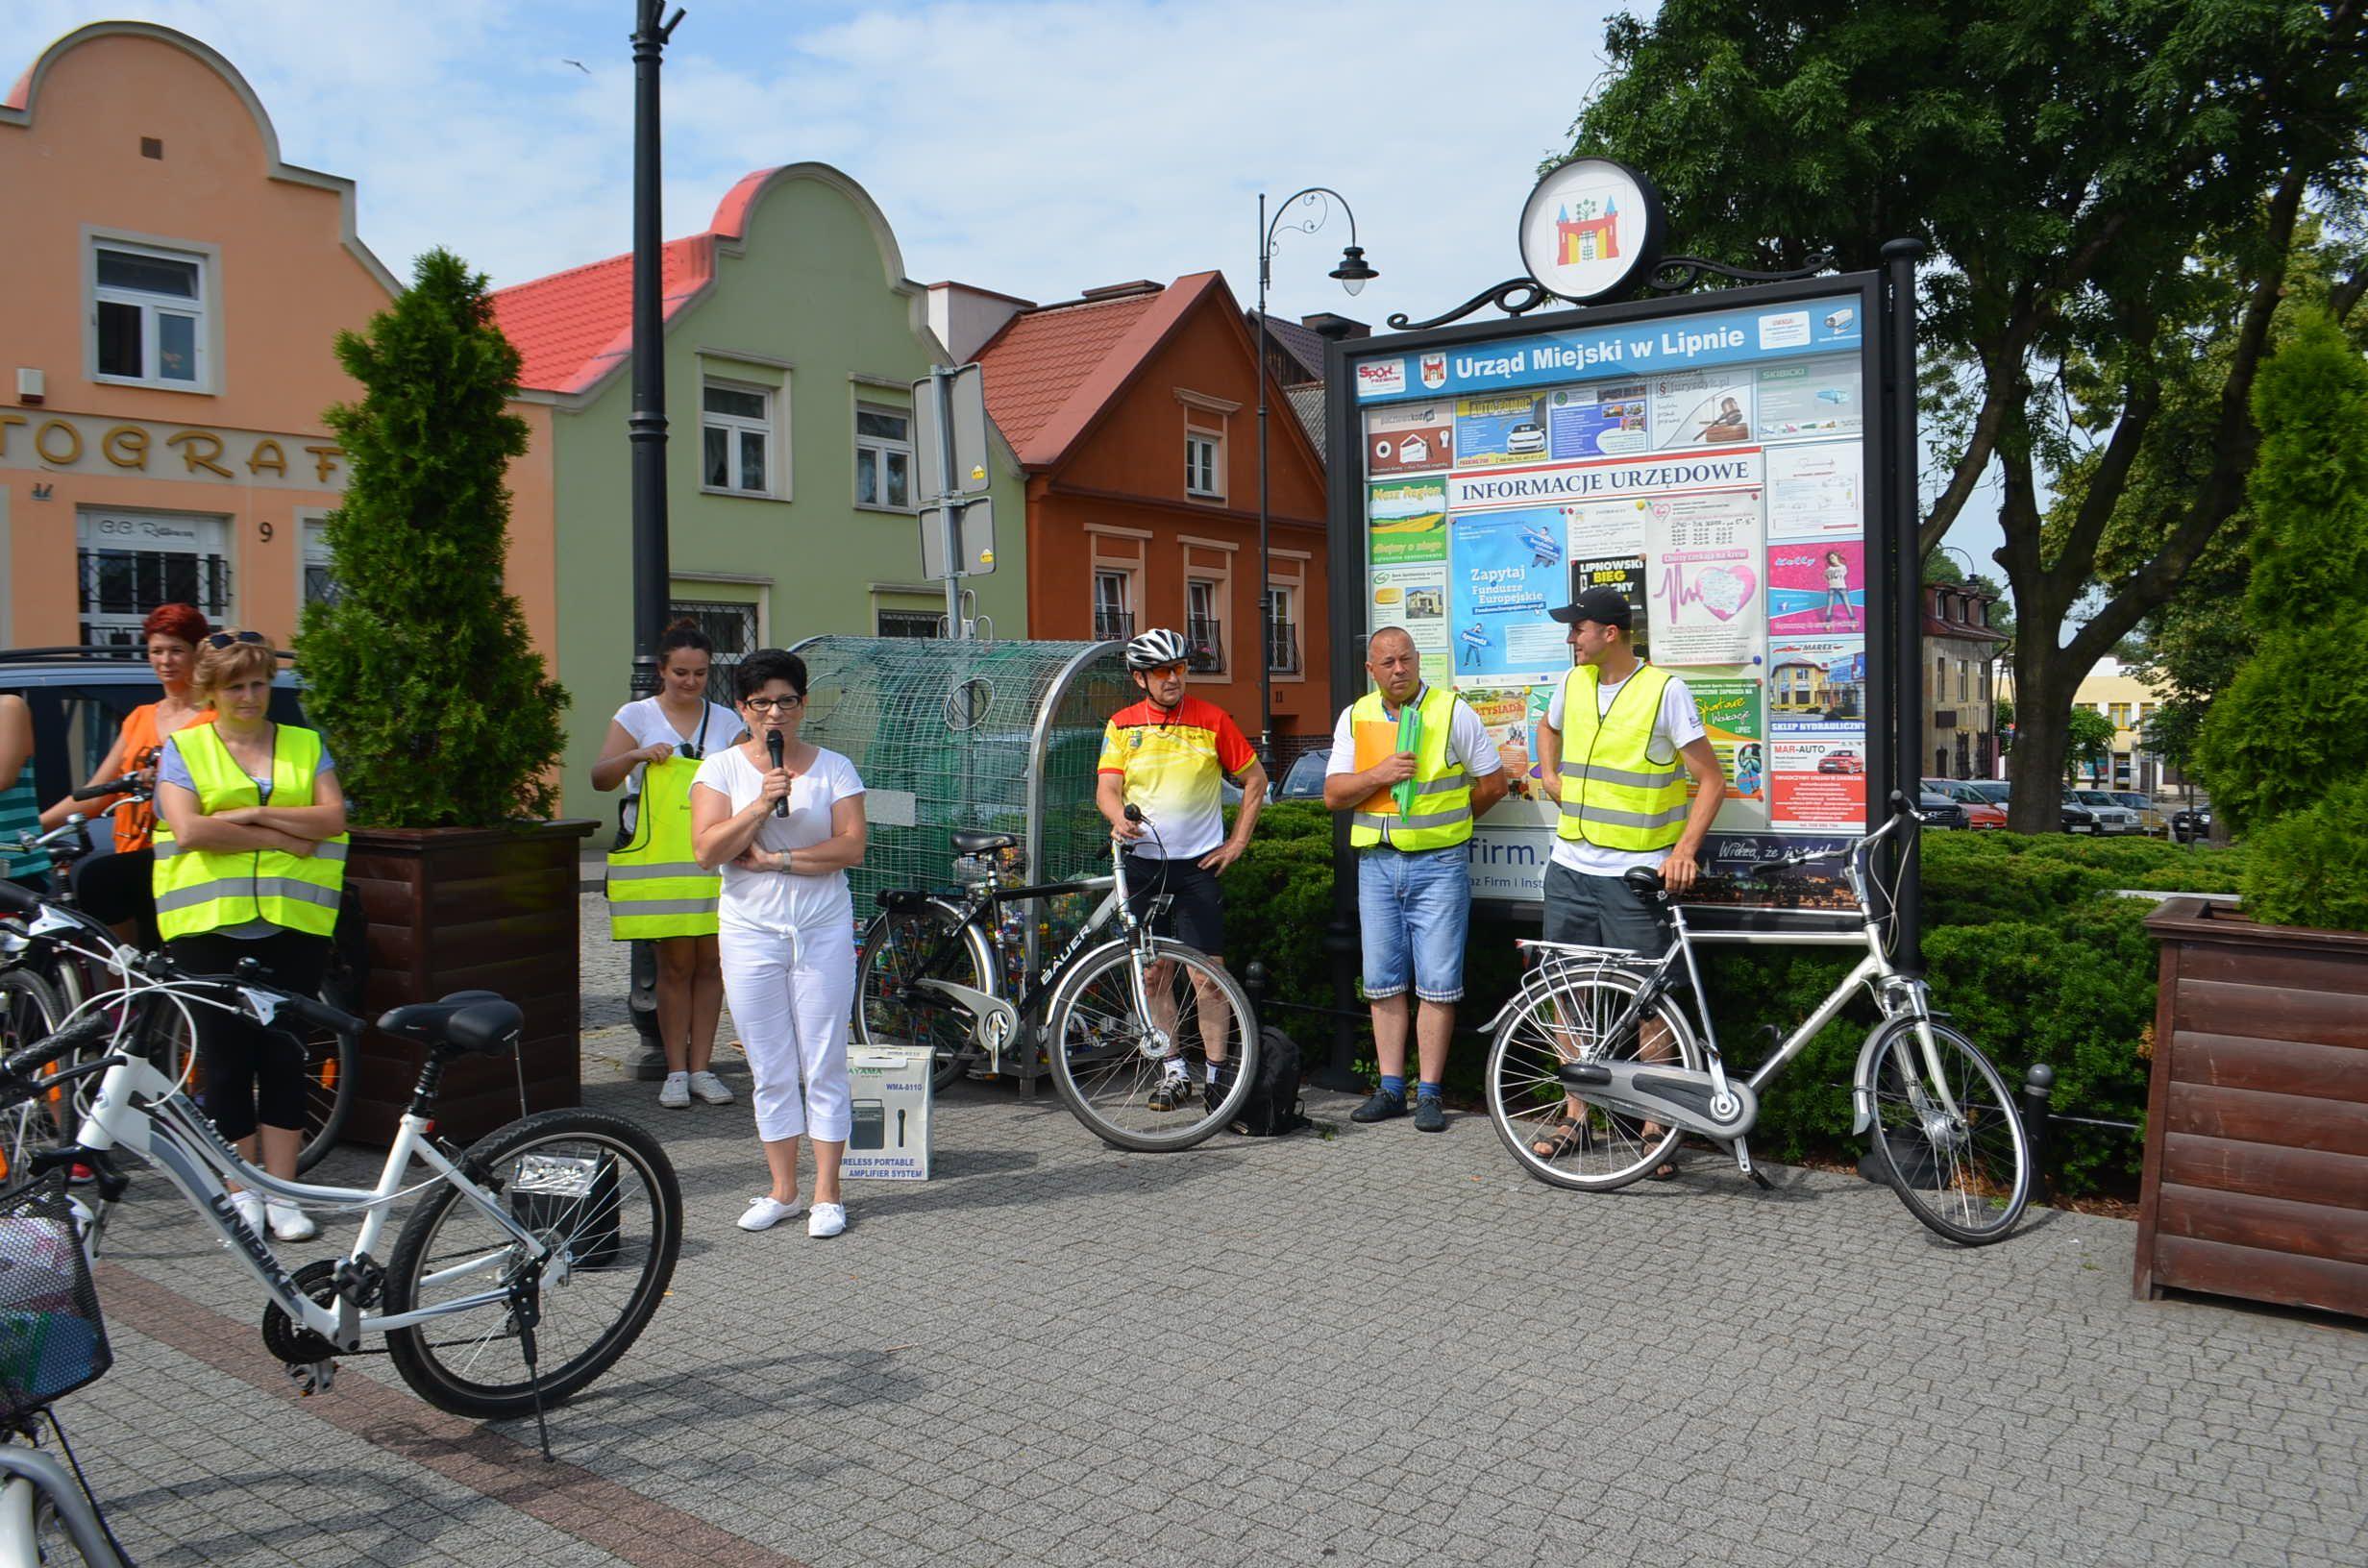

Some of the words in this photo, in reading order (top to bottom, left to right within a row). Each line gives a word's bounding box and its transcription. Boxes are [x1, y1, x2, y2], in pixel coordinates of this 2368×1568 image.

[1456, 351, 1524, 378] Urząd
[1533, 339, 1622, 370] Miejski
[1630, 338, 1654, 358] w
[1662, 327, 1745, 356] Lipnie
[1462, 474, 1603, 501] INFORMACJE
[1612, 461, 1749, 489] URZĘDOWE
[258, 522, 274, 543] 9
[1579, 559, 1643, 573] LIPNOWSKI
[1470, 565, 1525, 581] Zapytaj
[1593, 570, 1626, 583] BIEG
[1472, 584, 1523, 595] Fundusze
[1478, 592, 1543, 604] Europejskie
[1275, 690, 1284, 702] 11
[1771, 723, 1799, 731] SKLEP
[1799, 722, 1865, 731] HYDRAULICZNY
[1774, 745, 1826, 753] MAR-AUTO
[1468, 837, 1553, 866] firm.
[1764, 845, 1779, 858] że
[1484, 876, 1511, 887] Firm
[1521, 876, 1543, 889] Inst
[1040, 924, 1092, 986] BAUER
[841, 1158, 873, 1166] RELESS
[874, 1158, 915, 1166] PORTABLE
[891, 1169, 923, 1178] SYSTEM
[210, 1192, 299, 1296] UNIBIKE
